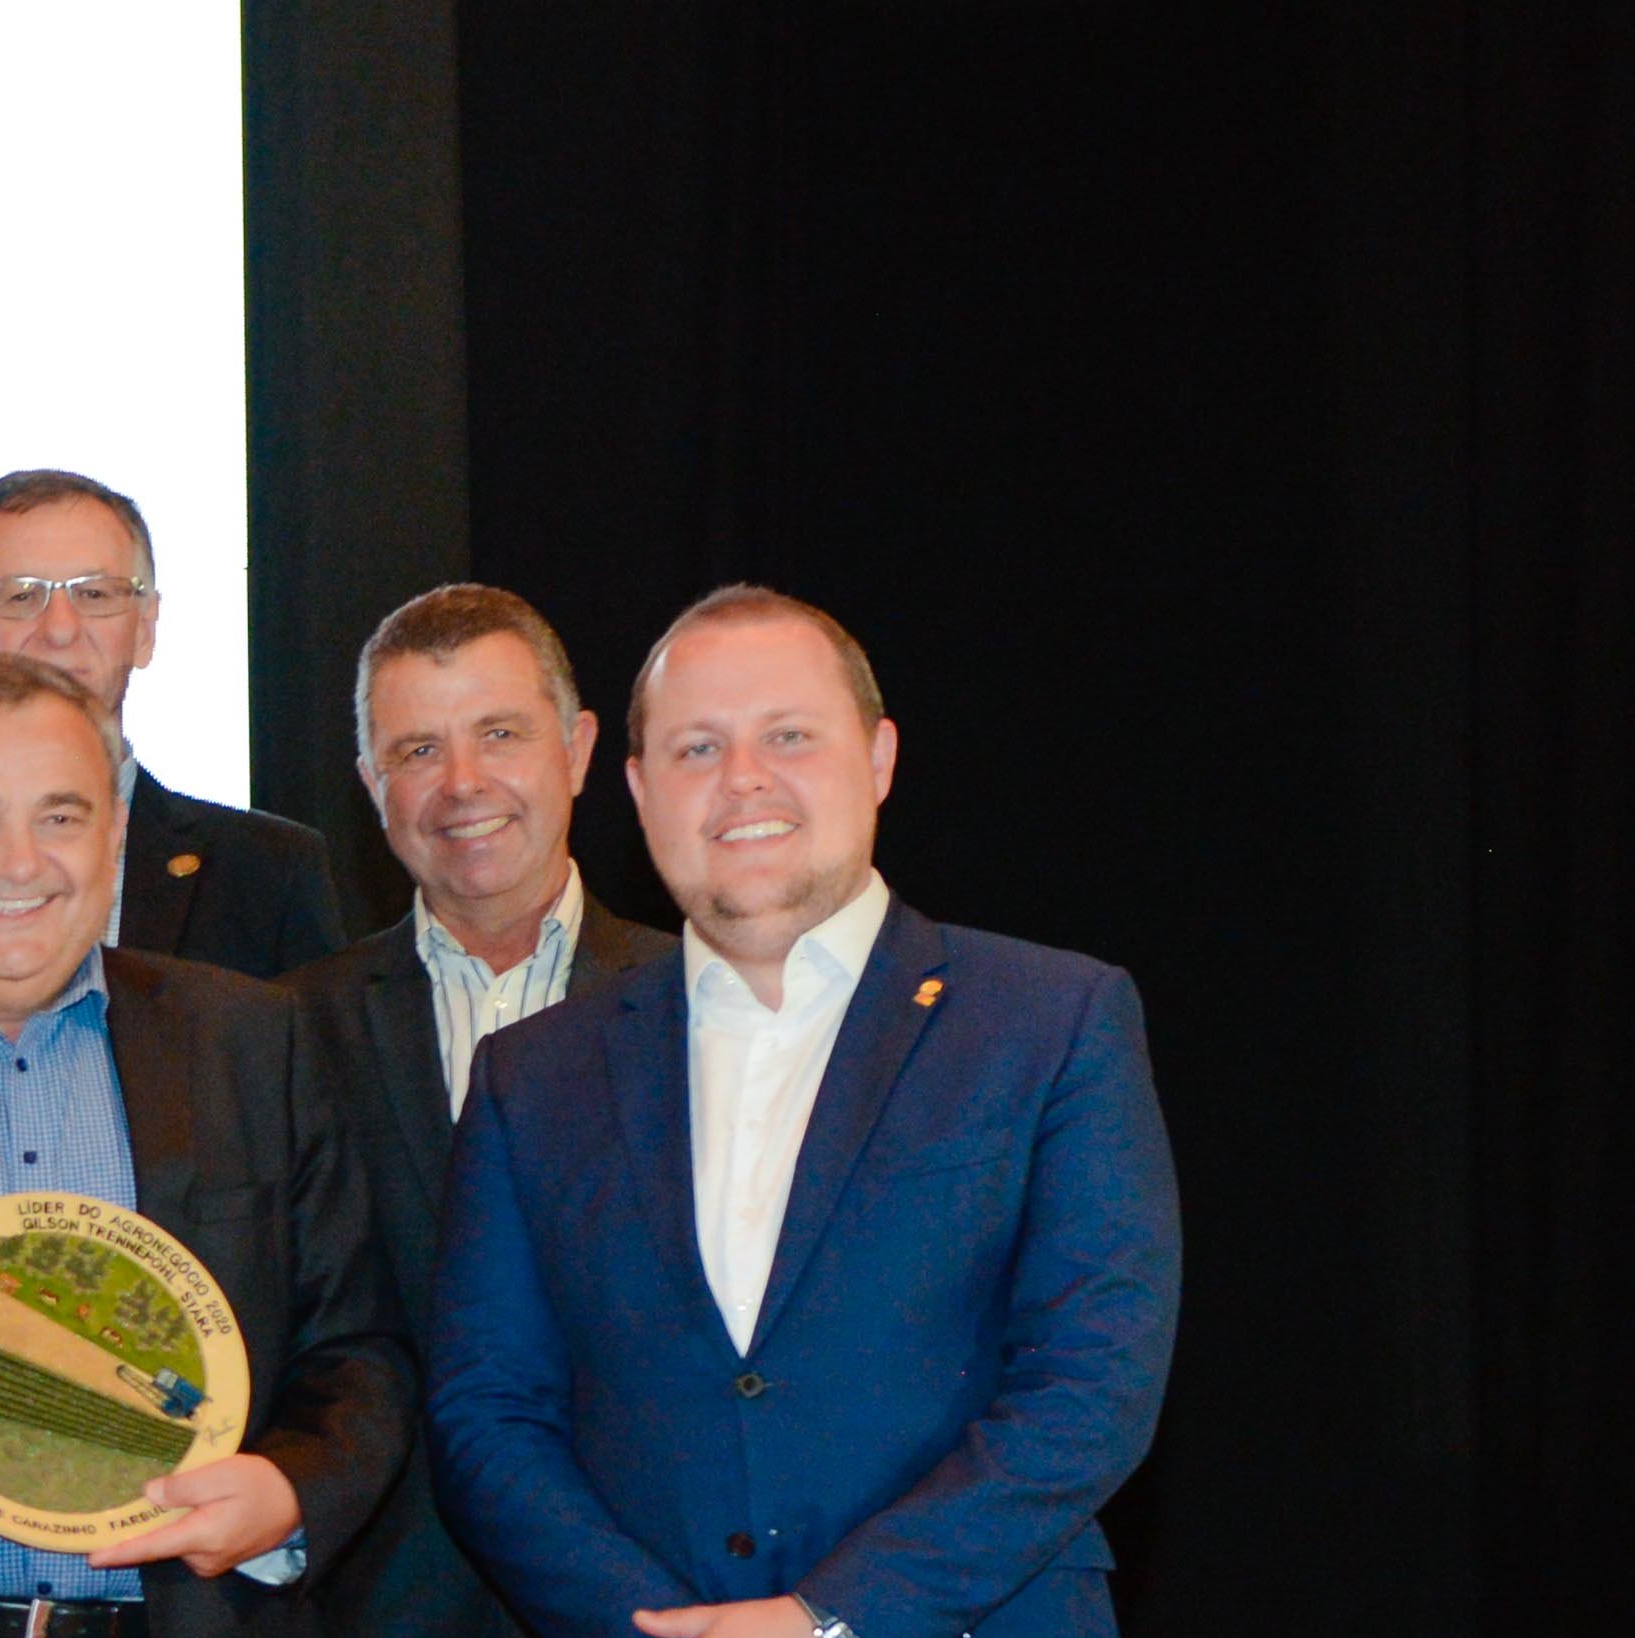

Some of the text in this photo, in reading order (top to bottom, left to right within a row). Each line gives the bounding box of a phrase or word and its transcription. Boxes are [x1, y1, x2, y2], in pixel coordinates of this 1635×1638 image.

[22, 1216, 80, 1232] GILSON
[180, 1290, 215, 1339] STARA
[78, 1202, 102, 1220] DO
[206, 1299, 233, 1336] 2020
